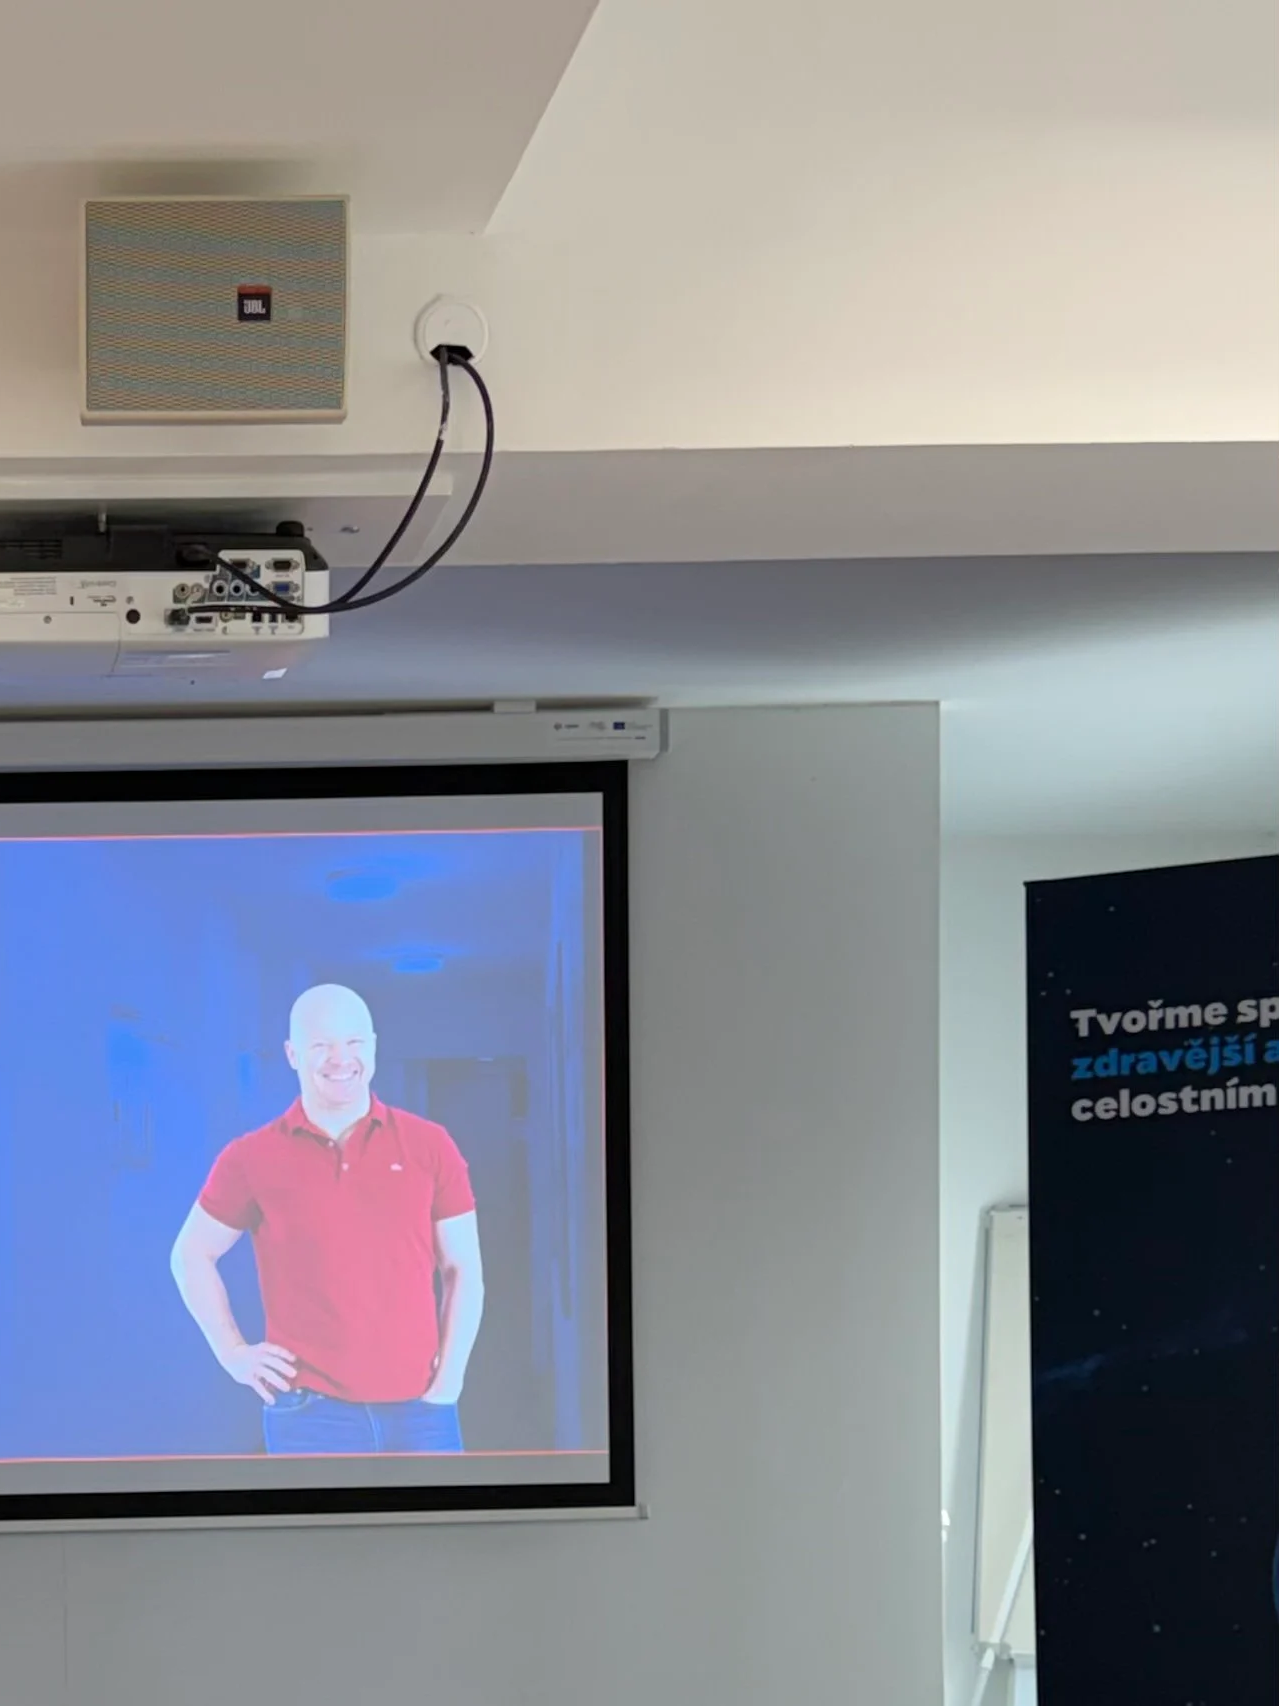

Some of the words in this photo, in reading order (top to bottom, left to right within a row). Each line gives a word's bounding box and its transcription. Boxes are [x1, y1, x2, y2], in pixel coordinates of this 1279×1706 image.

[243, 299, 266, 315] JBL
[1069, 998, 1229, 1037] Tvořme
[1071, 1032, 1258, 1080] zdravější
[1071, 1076, 1278, 1121] celostním
